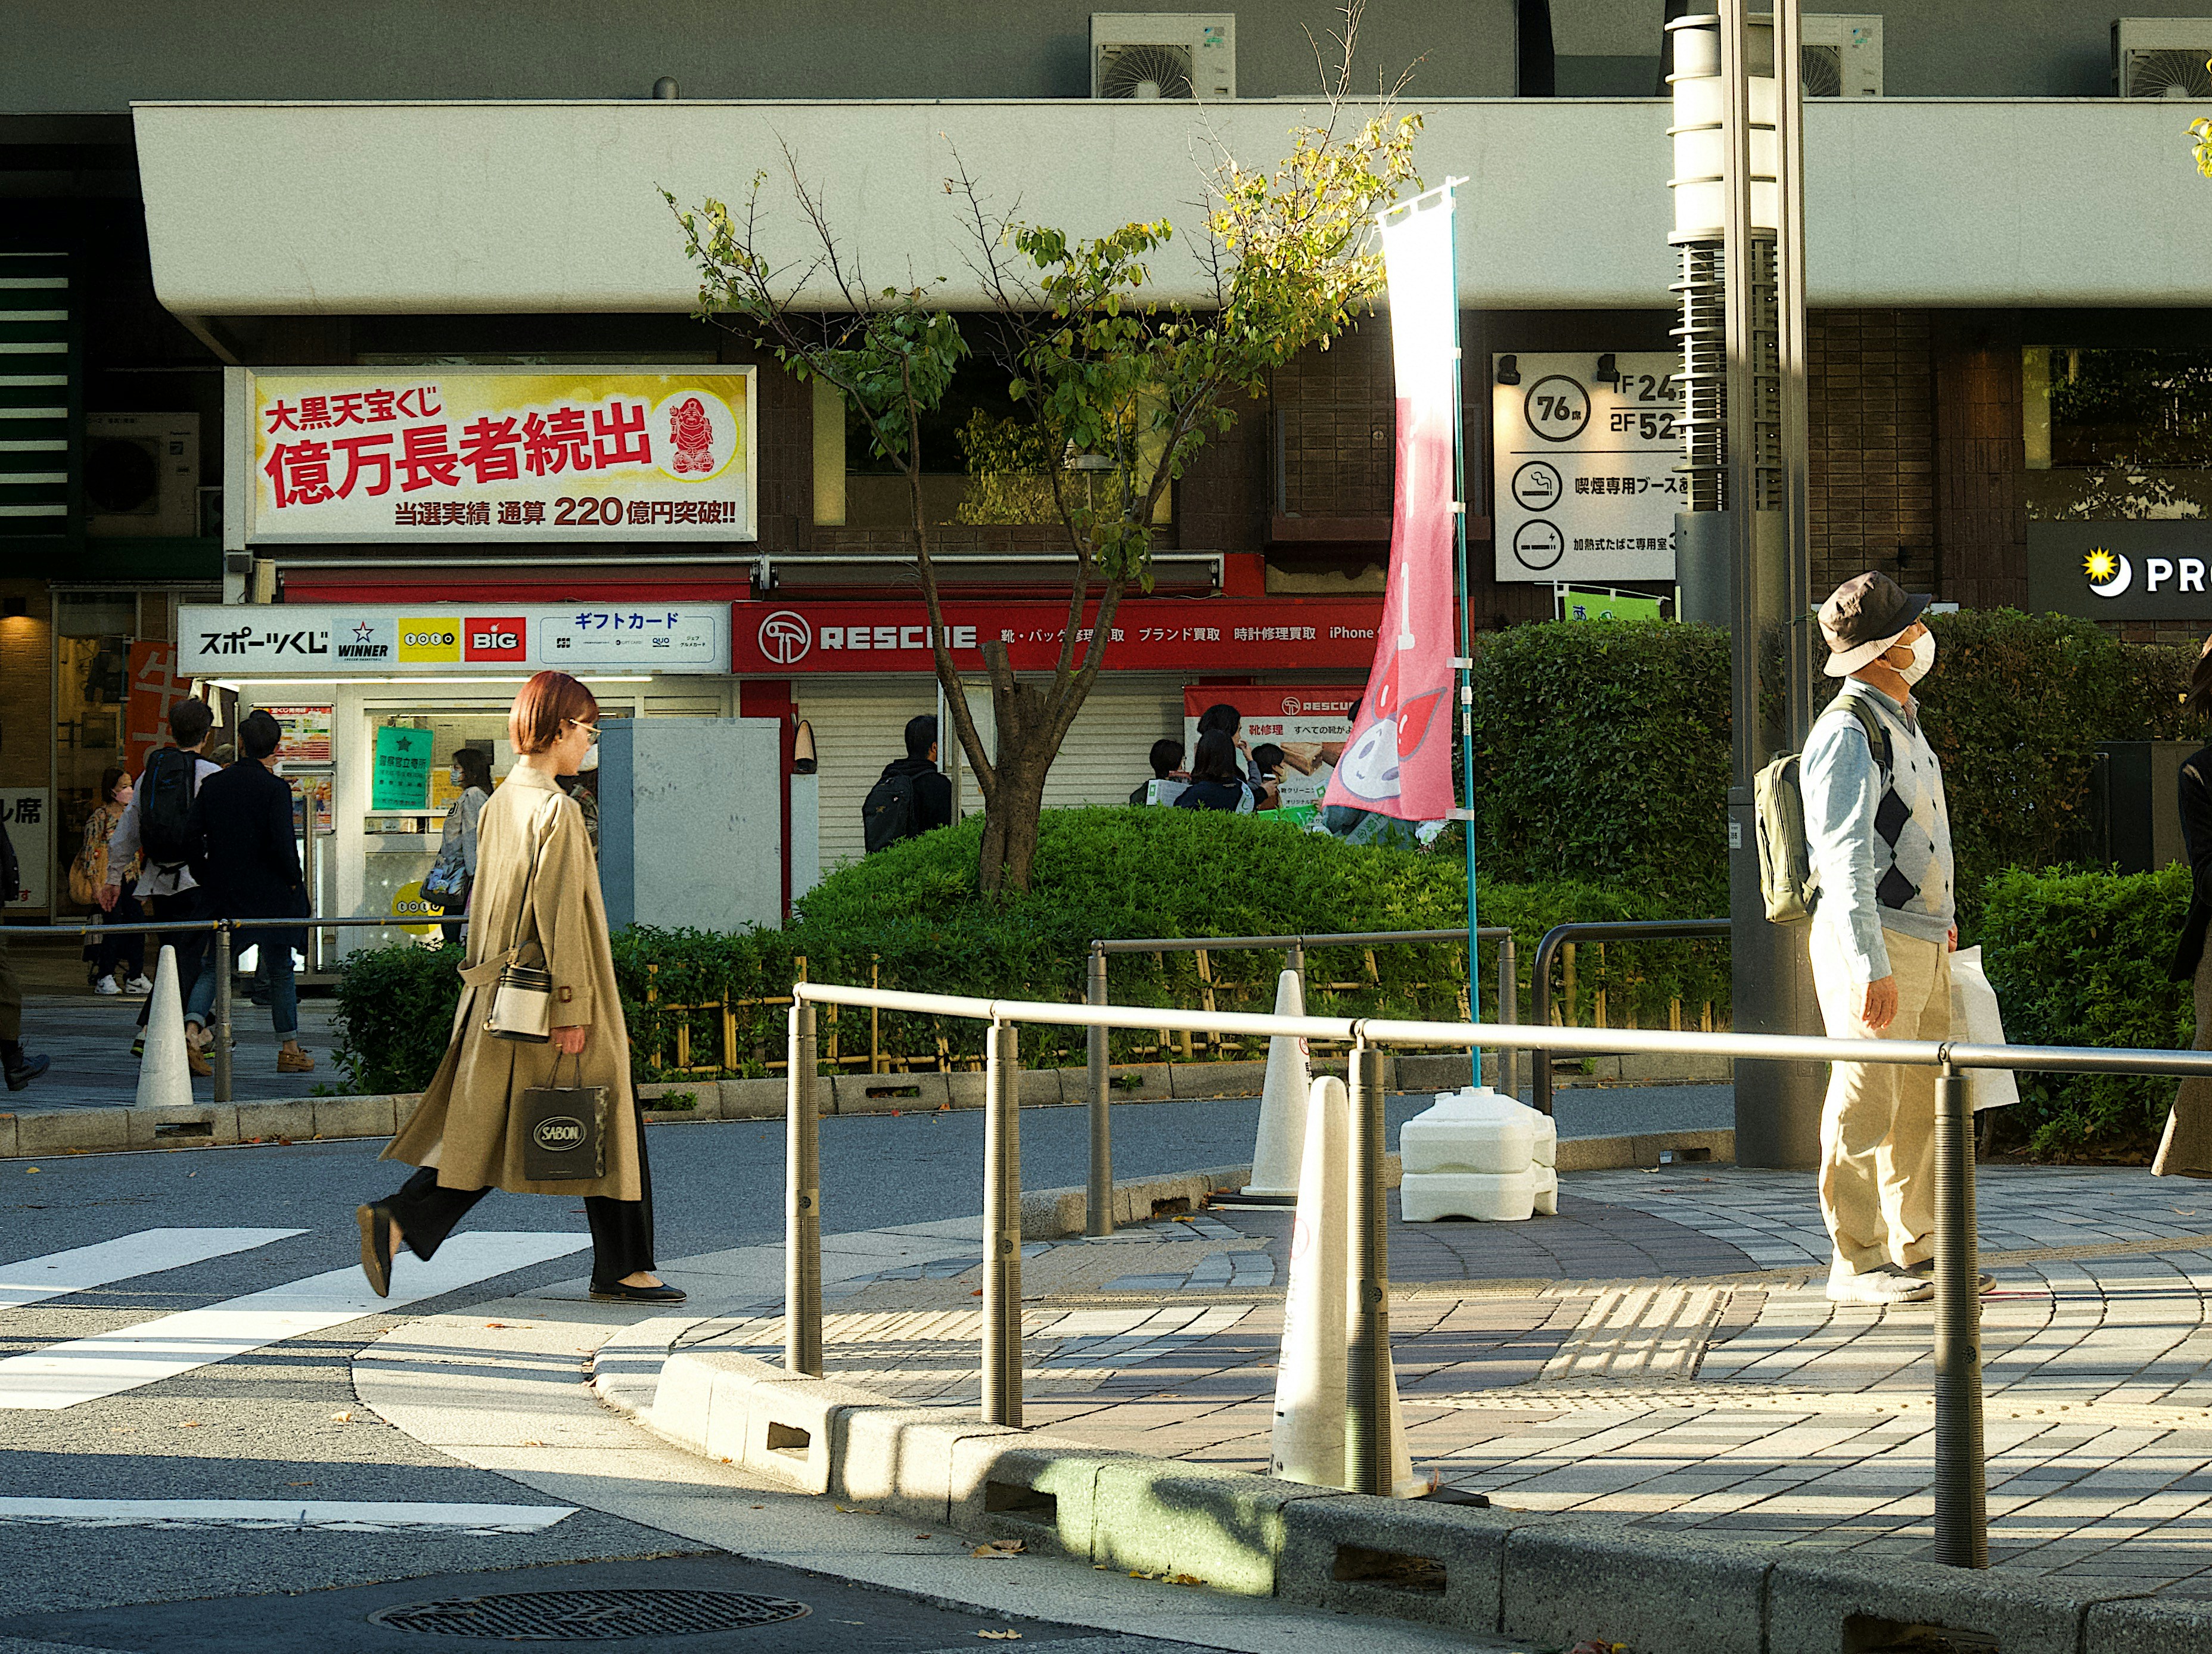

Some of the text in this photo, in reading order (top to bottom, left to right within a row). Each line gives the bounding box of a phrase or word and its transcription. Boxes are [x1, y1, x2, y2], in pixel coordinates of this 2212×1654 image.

[1639, 375, 1686, 401] 24
[266, 386, 442, 434] 大黒天宝くじ
[1611, 413, 1686, 440] 2F 52
[264, 402, 652, 508] 億万長者続出
[395, 497, 735, 526] 当選実績 通算 220 億円突破!!
[2146, 558, 2212, 592] PR
[575, 613, 679, 629] ギフトカード
[199, 626, 328, 654] スポーツくじ
[404, 632, 455, 646] toto
[820, 626, 977, 649] RESCUE
[1139, 627, 1220, 642] ブランド買取
[1234, 627, 1316, 641] 時計修理買取
[1329, 626, 1374, 639] iPhone
[338, 645, 389, 657] WINNER
[1249, 725, 1283, 735] 靴修理
[541, 1126, 579, 1140] SABON
